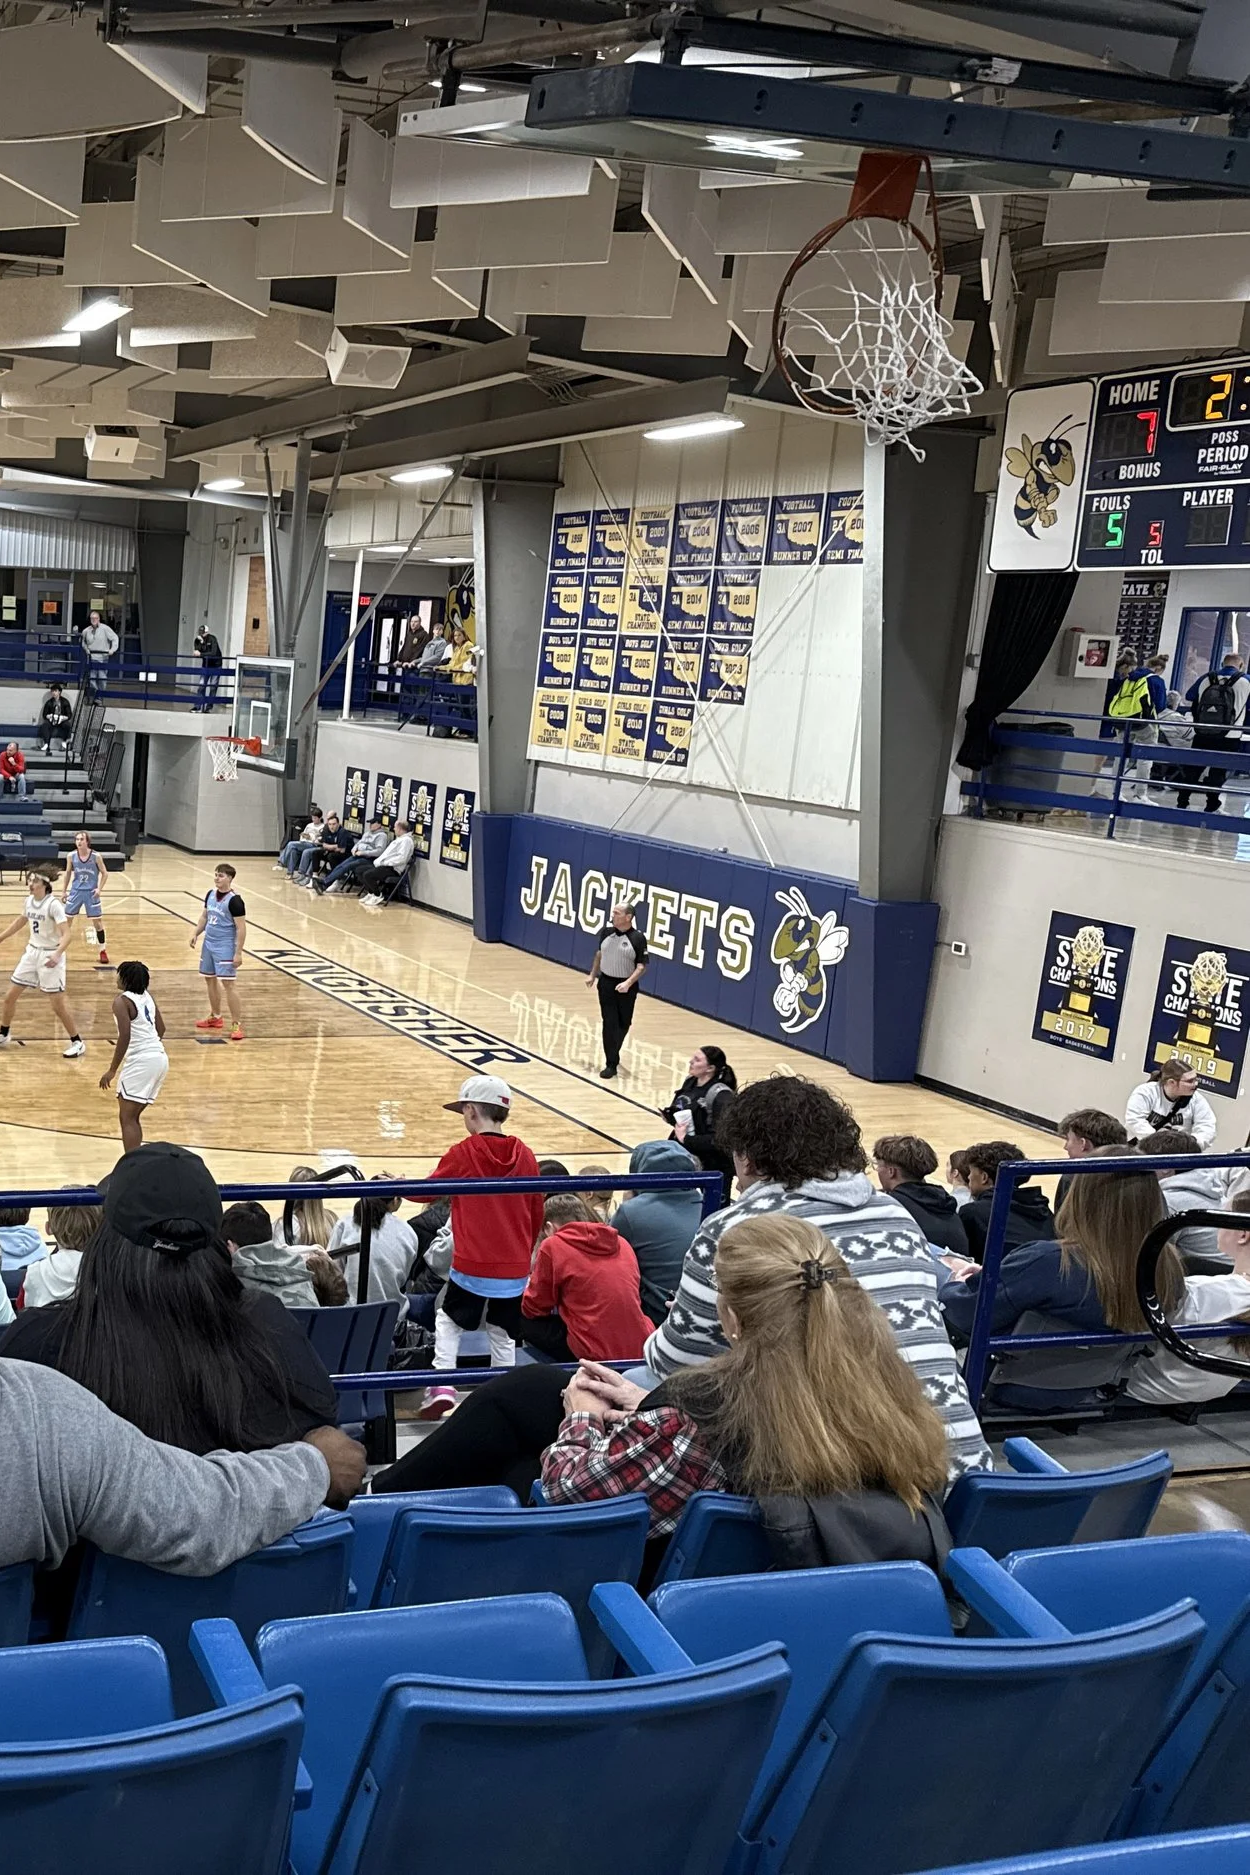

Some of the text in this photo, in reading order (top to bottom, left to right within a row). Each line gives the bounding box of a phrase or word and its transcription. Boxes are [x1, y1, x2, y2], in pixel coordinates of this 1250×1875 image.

[1109, 380, 1160, 406] HOME
[1137, 412, 1157, 454] 7
[1211, 430, 1239, 444] POSS
[1197, 445, 1249, 464] PERIOD
[1119, 462, 1161, 479] BONUS
[1198, 463, 1243, 472] FAIR-PLAY
[783, 499, 815, 510] FOOTBALL
[1092, 495, 1131, 511] FOULS
[1182, 489, 1234, 506] PLAYER
[793, 521, 812, 532] 2007
[1105, 513, 1123, 547] 5
[1148, 523, 1160, 546] 5
[803, 551, 812, 560] UP
[1140, 549, 1164, 564] TOL
[1122, 584, 1149, 595] TATE
[687, 594, 702, 604] 2014
[520, 855, 755, 981] JACKETS
[33, 921, 39, 933] 2
[252, 950, 531, 1066] KINGFISHER
[1055, 1018, 1095, 1039] 2017
